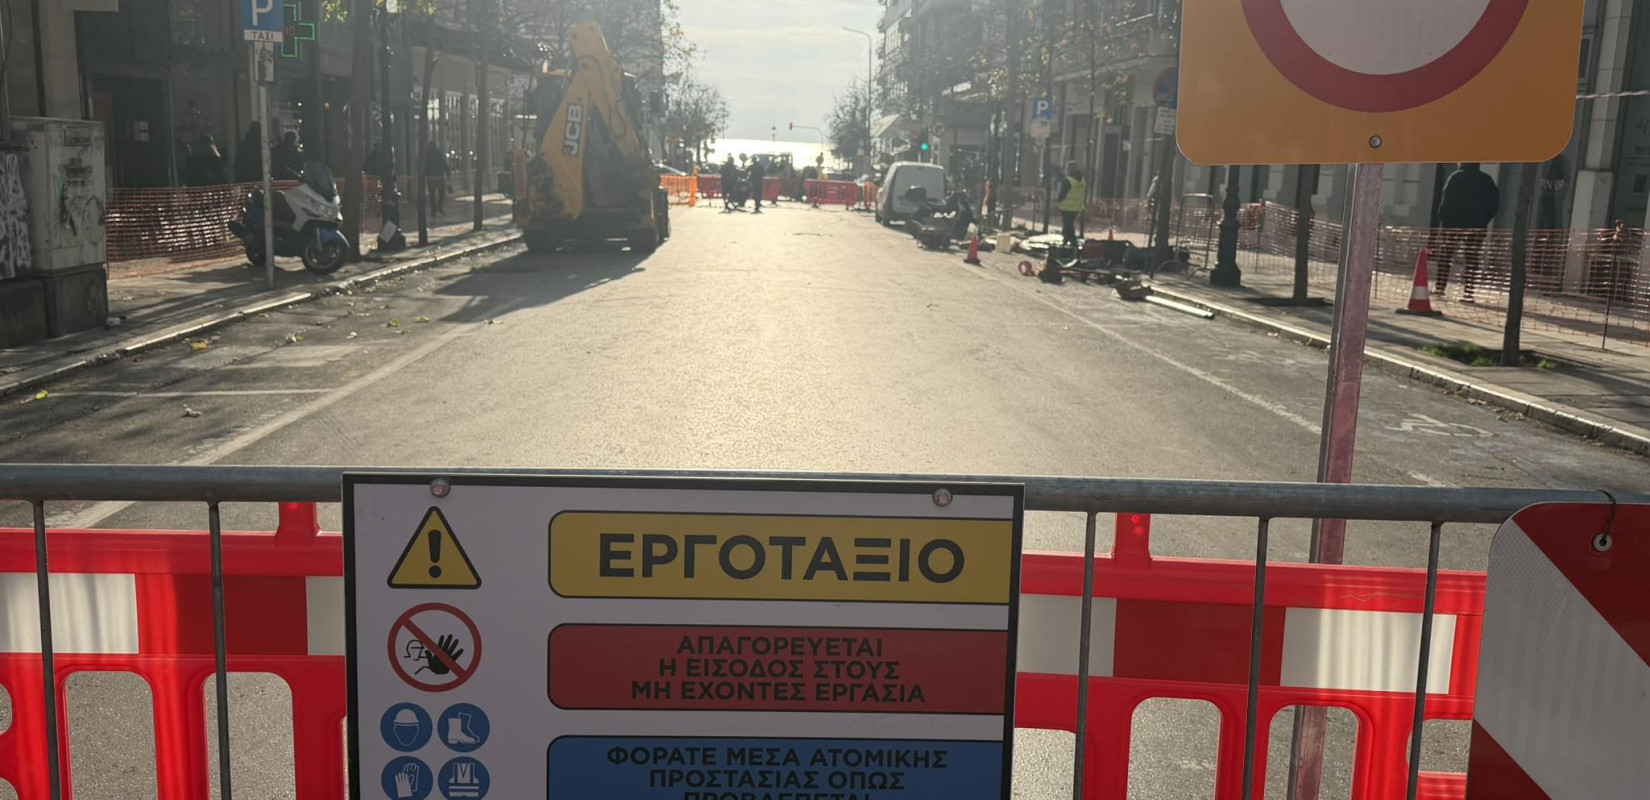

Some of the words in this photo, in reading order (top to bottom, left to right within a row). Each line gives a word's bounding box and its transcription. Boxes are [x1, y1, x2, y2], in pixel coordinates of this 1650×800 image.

[252, 0, 273, 26] P
[252, 31, 273, 40] ΤΑΞΙ
[1036, 100, 1049, 115] P
[564, 104, 582, 155] JCB
[598, 531, 966, 584] ΕΡΓΟΤΑΞΙΟ
[677, 635, 883, 658] ΑΠΑΓΟΡΕΥΕΤΑΙ
[659, 658, 677, 677] Η
[686, 658, 804, 679] ΕΙΣΟΔΟΣ
[813, 660, 900, 681] ΣΤΟΥΣ
[631, 680, 672, 701] ΜΗ
[681, 680, 806, 702] ΕΧΟΝΤΕΣ
[815, 682, 926, 703] ΕΡΓΑΣΙΑ
[607, 746, 717, 766] ΦΟΡΑΤΕ
[726, 747, 801, 767] ΜΕΣΑ
[809, 748, 948, 769] ΑΤΟΜΙΚΗΣ
[649, 769, 820, 789] ΠΡΟΣΤΑΣΙΑΣ
[827, 770, 905, 791] ΟΠΩΣ
